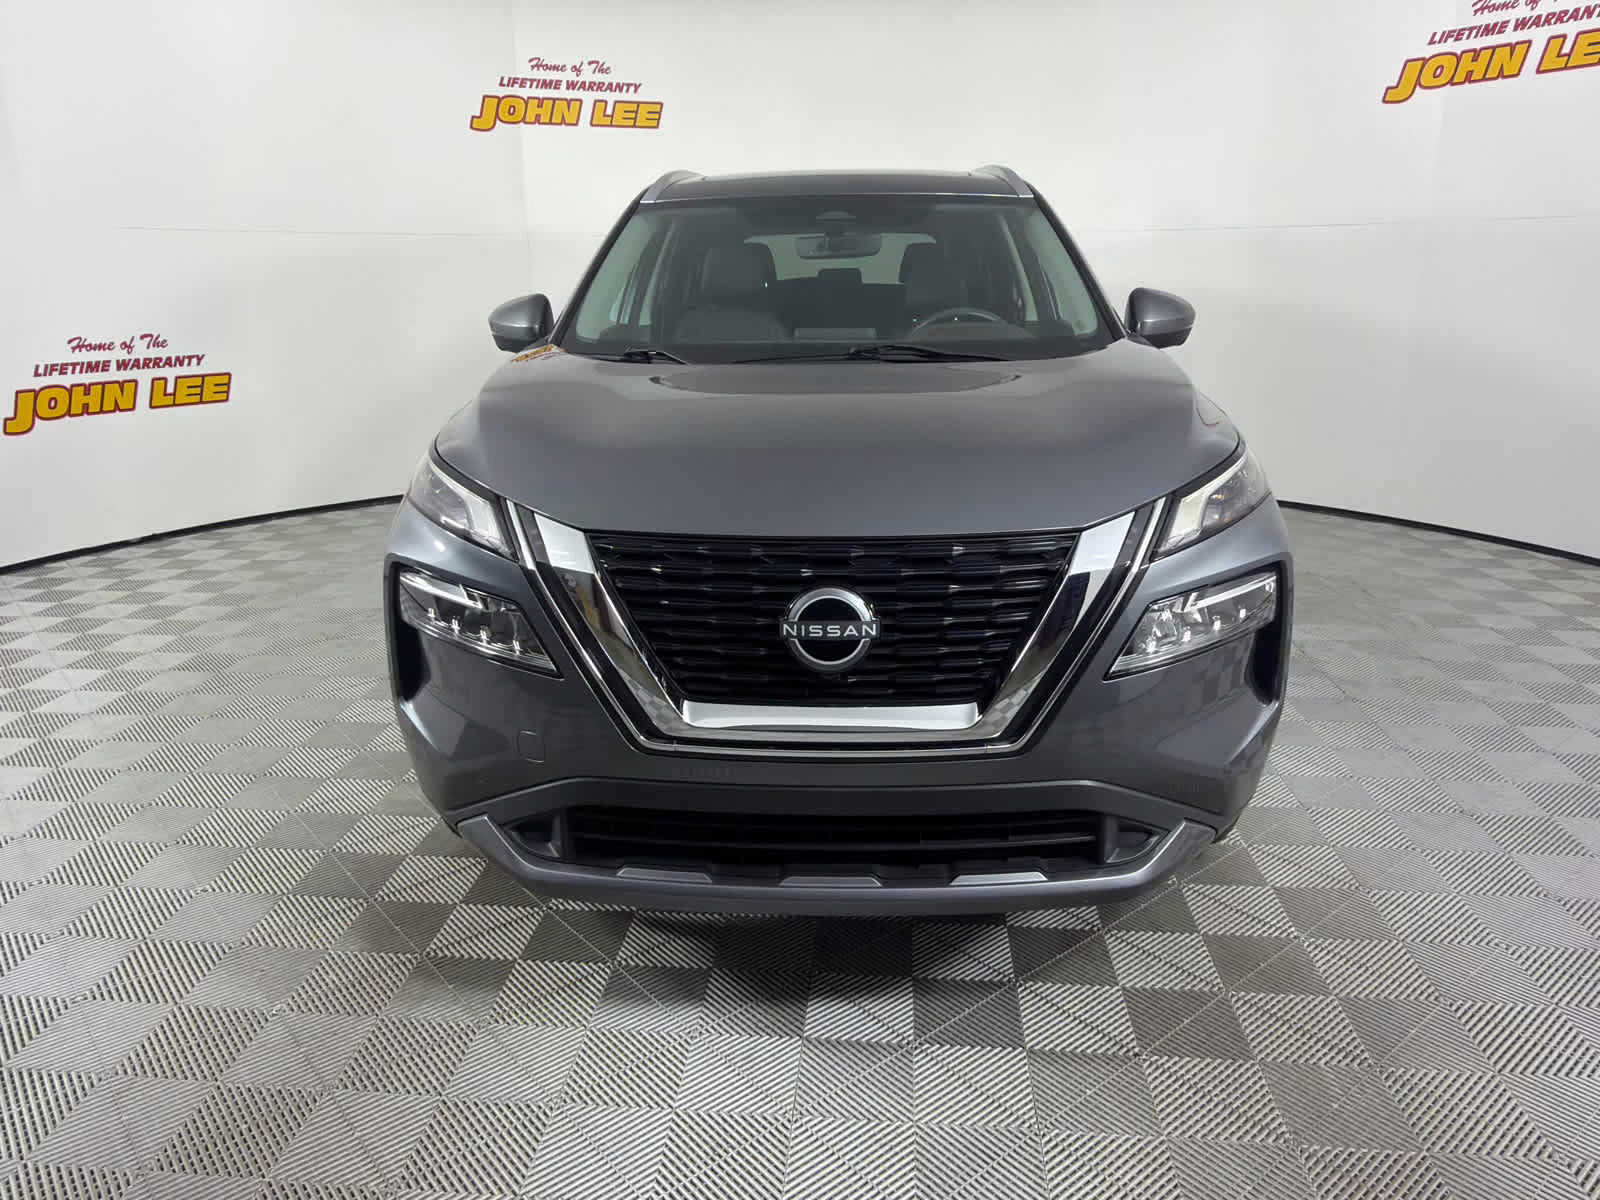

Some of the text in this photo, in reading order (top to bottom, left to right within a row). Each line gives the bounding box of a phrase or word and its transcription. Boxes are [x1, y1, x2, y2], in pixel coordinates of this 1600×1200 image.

[1427, 3, 1600, 46] LIFETIME WARRAN
[528, 57, 612, 77] Home of The
[1382, 39, 1532, 104] JOHN
[499, 76, 642, 94] LIFETIME WARRANTY
[470, 94, 664, 132] JOHN LEE
[67, 333, 169, 355] Home of The
[33, 354, 206, 378] LIFETIME WARRANTY
[3, 372, 232, 436] JOHN LEE
[783, 623, 877, 637] NISSAN
